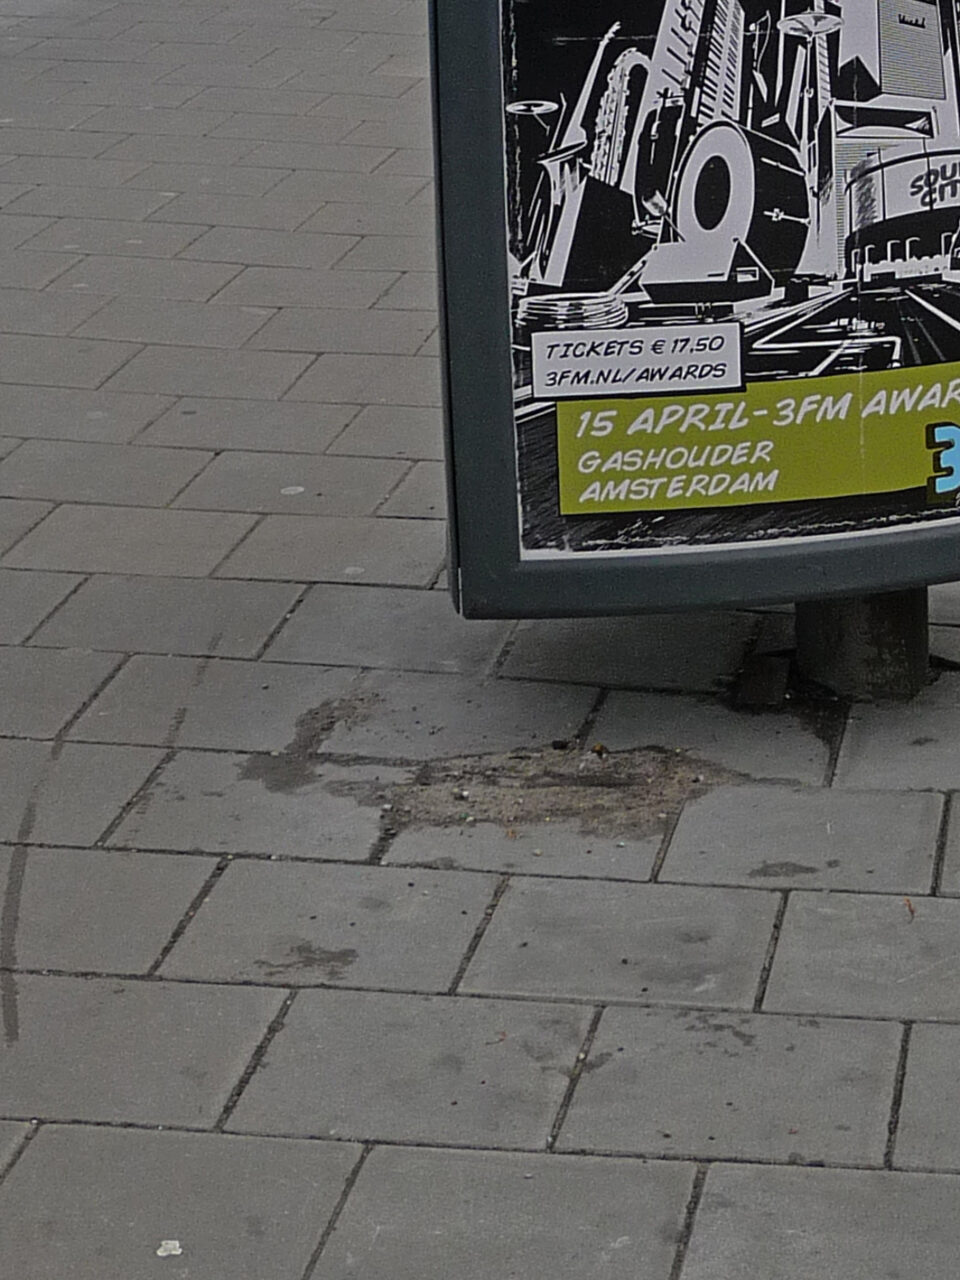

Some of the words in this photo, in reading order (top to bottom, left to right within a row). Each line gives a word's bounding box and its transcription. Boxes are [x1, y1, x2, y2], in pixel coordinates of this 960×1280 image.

[545, 339, 645, 360] TICKETS
[651, 338, 666, 354] €
[545, 363, 727, 388] 3FM.NL/AWARDS
[576, 410, 618, 438] 15
[577, 440, 774, 474] GASHOUDER
[578, 469, 780, 504] AMSTERDAM
